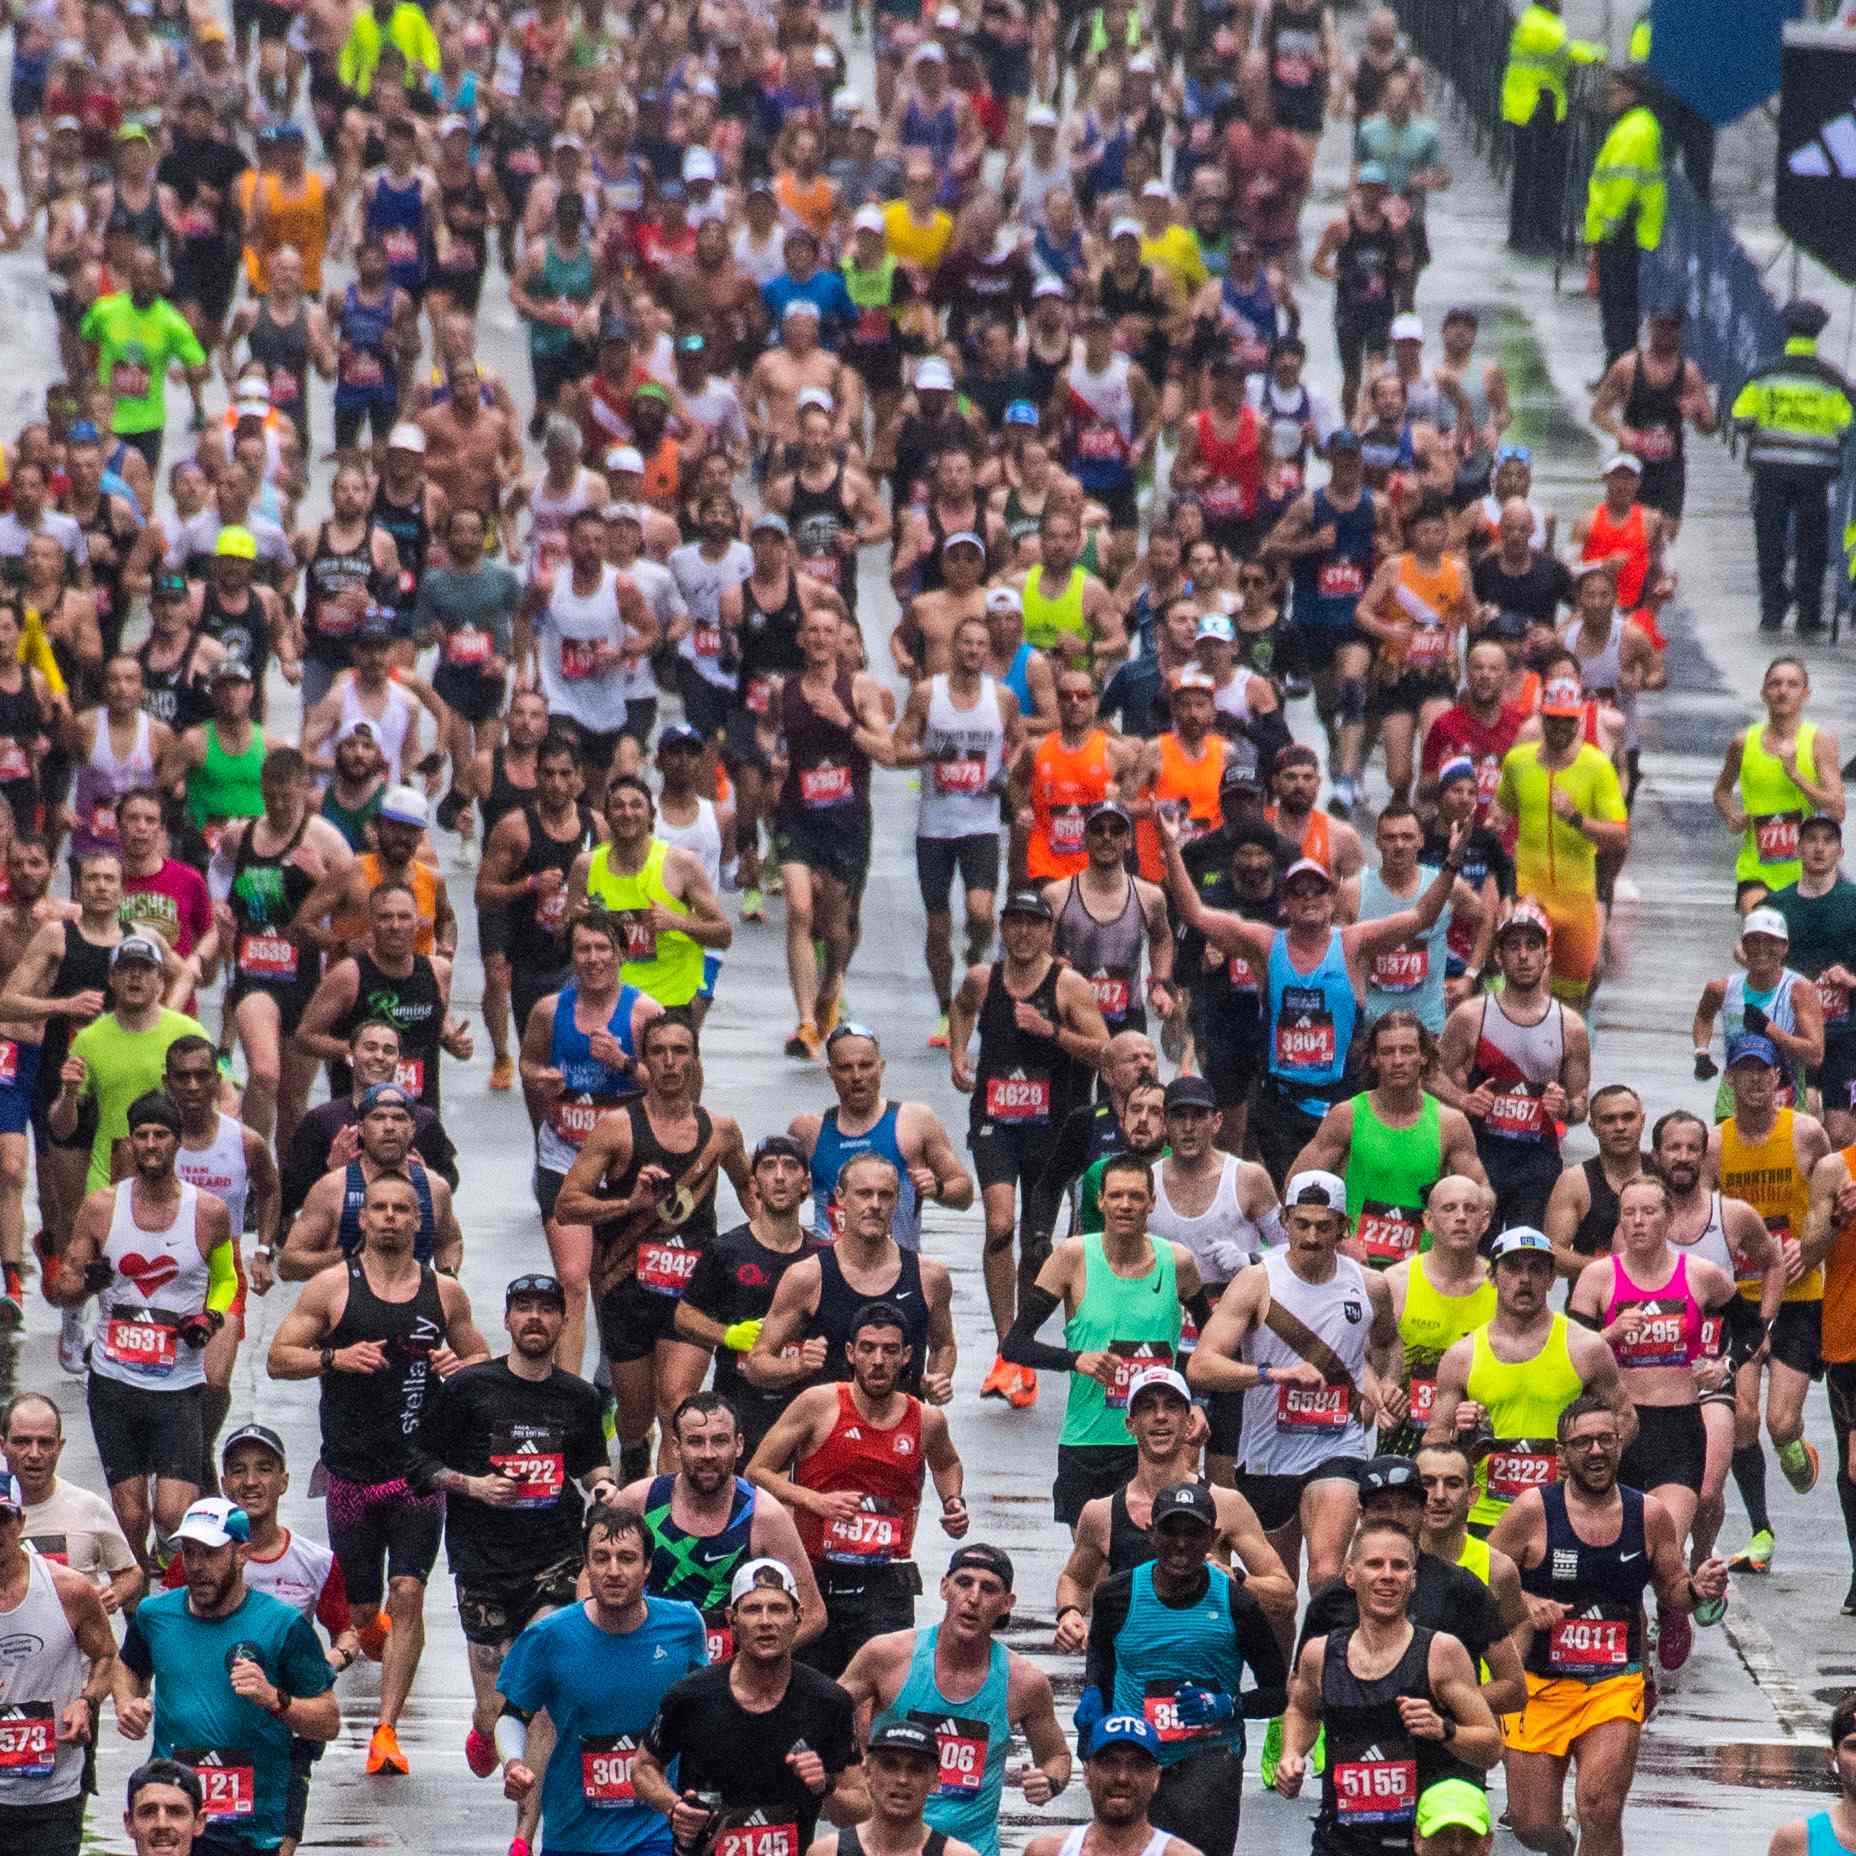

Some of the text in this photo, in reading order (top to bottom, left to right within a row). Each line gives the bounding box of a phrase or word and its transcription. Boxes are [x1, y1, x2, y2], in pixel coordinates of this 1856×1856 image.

[646, 1250, 696, 1278] 2942
[116, 1326, 168, 1353] 3531
[1493, 1457, 1549, 1482] 2322
[1560, 1625, 1617, 1651] 4011
[1104, 1716, 1147, 1738] CTS
[200, 1772, 242, 1802] 121
[1343, 1767, 1407, 1796] 5155
